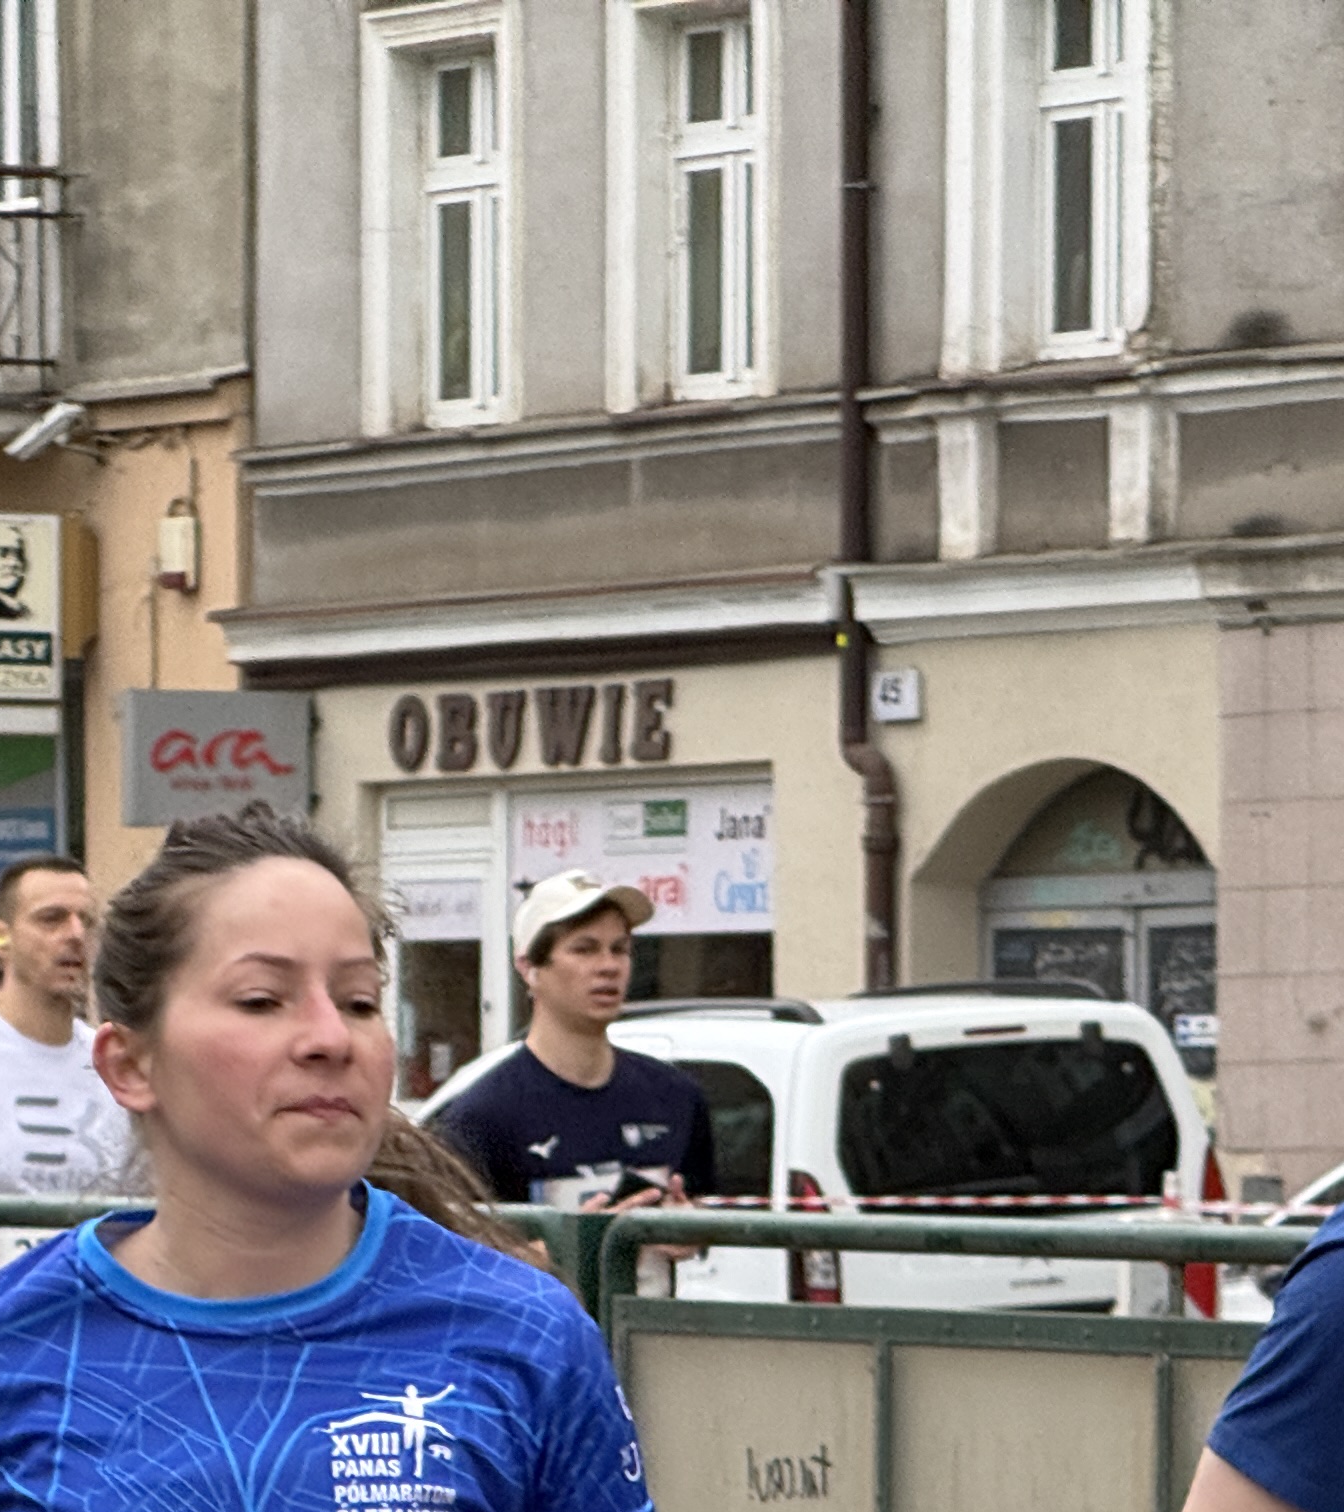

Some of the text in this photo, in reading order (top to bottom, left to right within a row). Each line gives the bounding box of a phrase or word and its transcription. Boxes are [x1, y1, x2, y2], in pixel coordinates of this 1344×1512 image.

[389, 679, 674, 773] OBUWIE
[150, 727, 296, 776] ara
[332, 1431, 400, 1456] XVIII
[331, 1458, 401, 1478] PANAS
